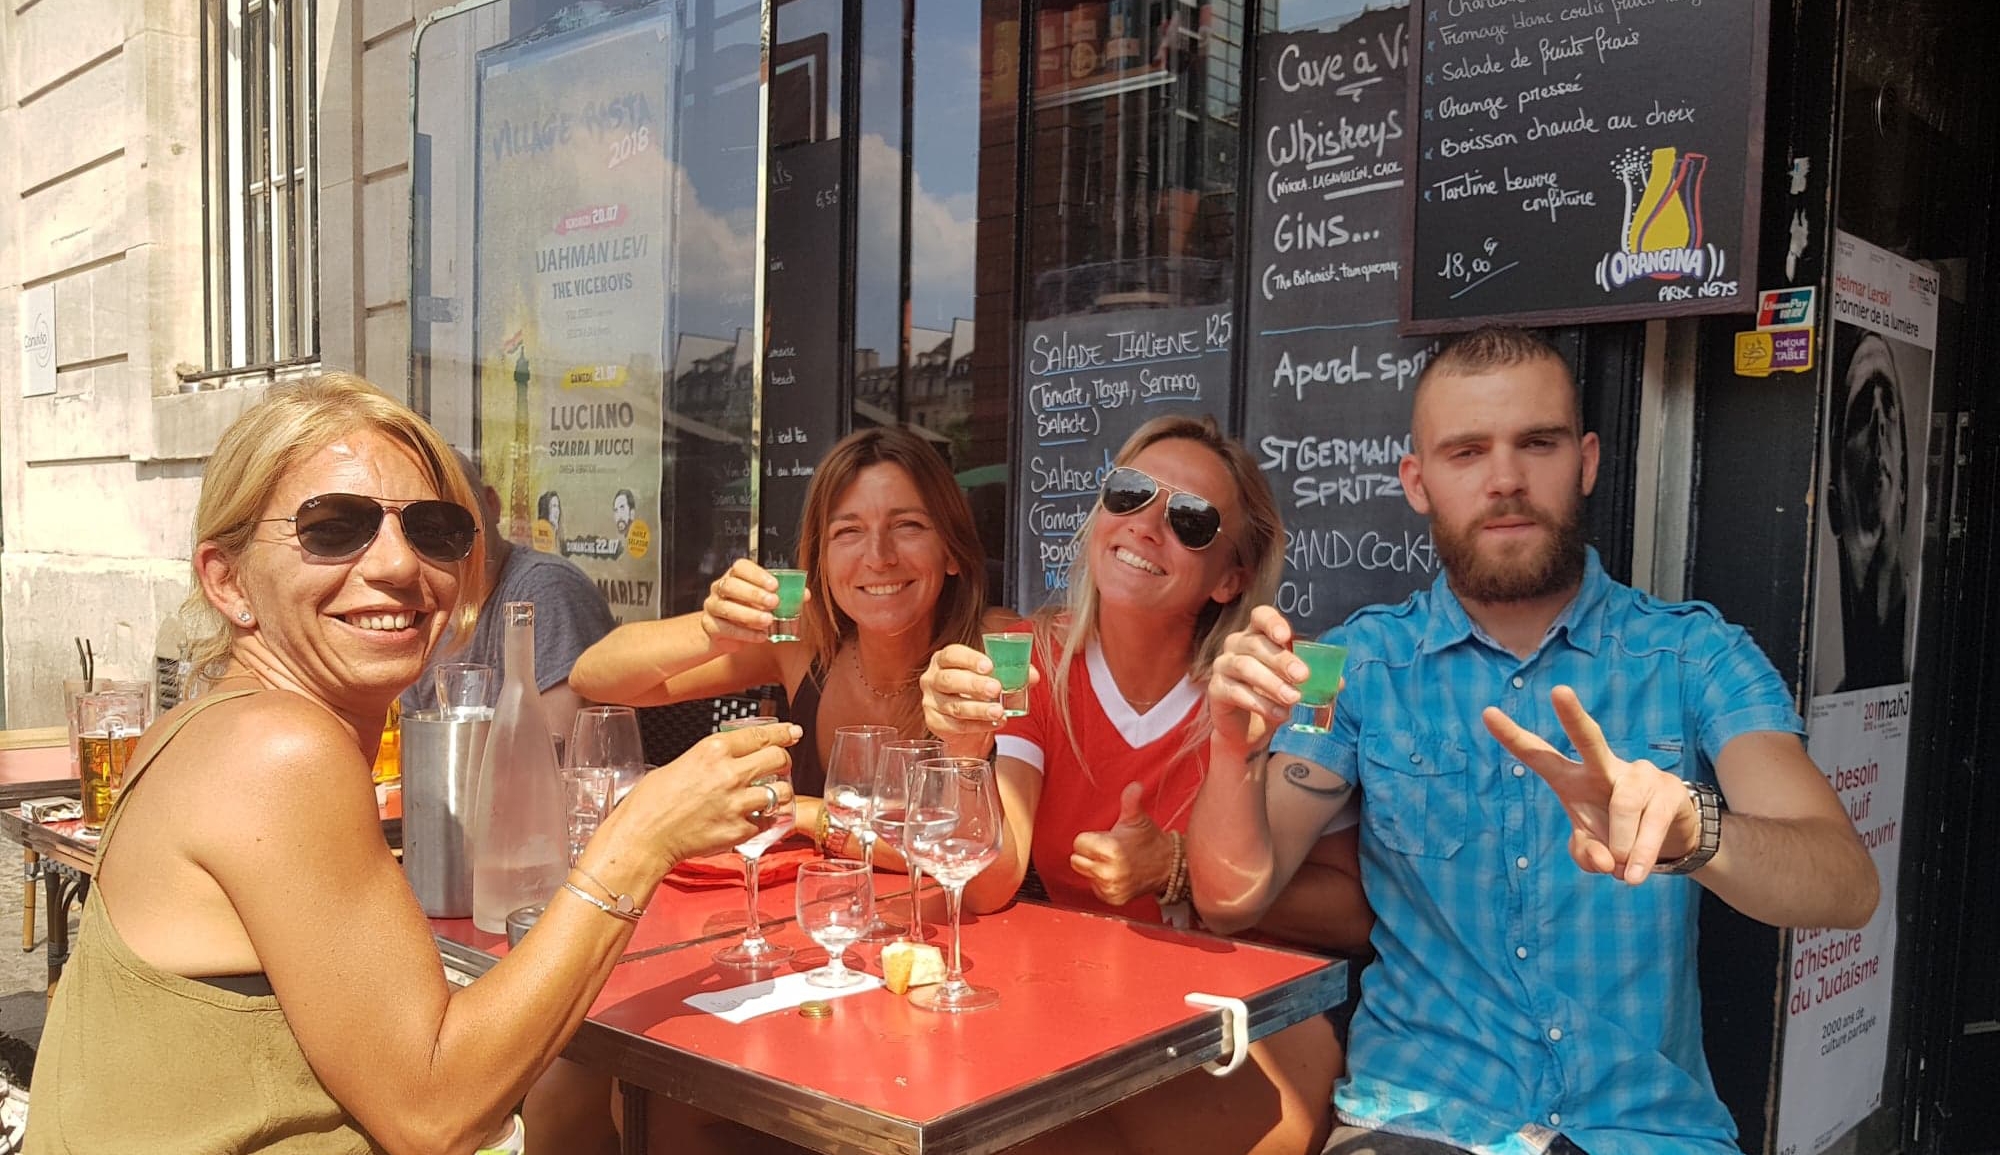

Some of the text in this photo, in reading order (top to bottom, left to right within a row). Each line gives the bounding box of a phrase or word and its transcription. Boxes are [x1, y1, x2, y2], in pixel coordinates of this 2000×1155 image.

[1439, 24, 1508, 46] Fromage
[1278, 22, 1409, 92] Cave à Vi
[1442, 26, 1640, 81] Salade de fruits frais
[1439, 95, 1507, 120] Orange
[1267, 109, 1403, 166] Whiskeys
[1441, 100, 1695, 158] Boisson chaude au choix
[608, 126, 649, 169] 2018
[1373, 162, 1403, 176] CAOL
[1432, 169, 1498, 202] Tartine
[1522, 186, 1596, 222] confiture
[612, 234, 649, 262] LEVI
[1611, 250, 1703, 285] ORANGINA
[552, 272, 634, 300] THE VICEROYS
[1659, 281, 1738, 302] PRIX NETS
[1835, 292, 1870, 320] Pionnier
[1870, 306, 1882, 325] de
[1882, 310, 1891, 328] la
[1775, 350, 1808, 360] TABLE
[551, 401, 634, 432] LUCIANO
[550, 437, 634, 458] SKARRA MUCCI
[1293, 473, 1405, 508] SPRITZ
[1285, 530, 1352, 572] RAND
[1836, 757, 1879, 793] besoin
[1794, 932, 1862, 980] d'histoire
[1790, 954, 1880, 1016] du Judaïsme
[1821, 1016, 1843, 1040] 2000
[1855, 1004, 1865, 1021] de
[1821, 1034, 1848, 1057] culture
